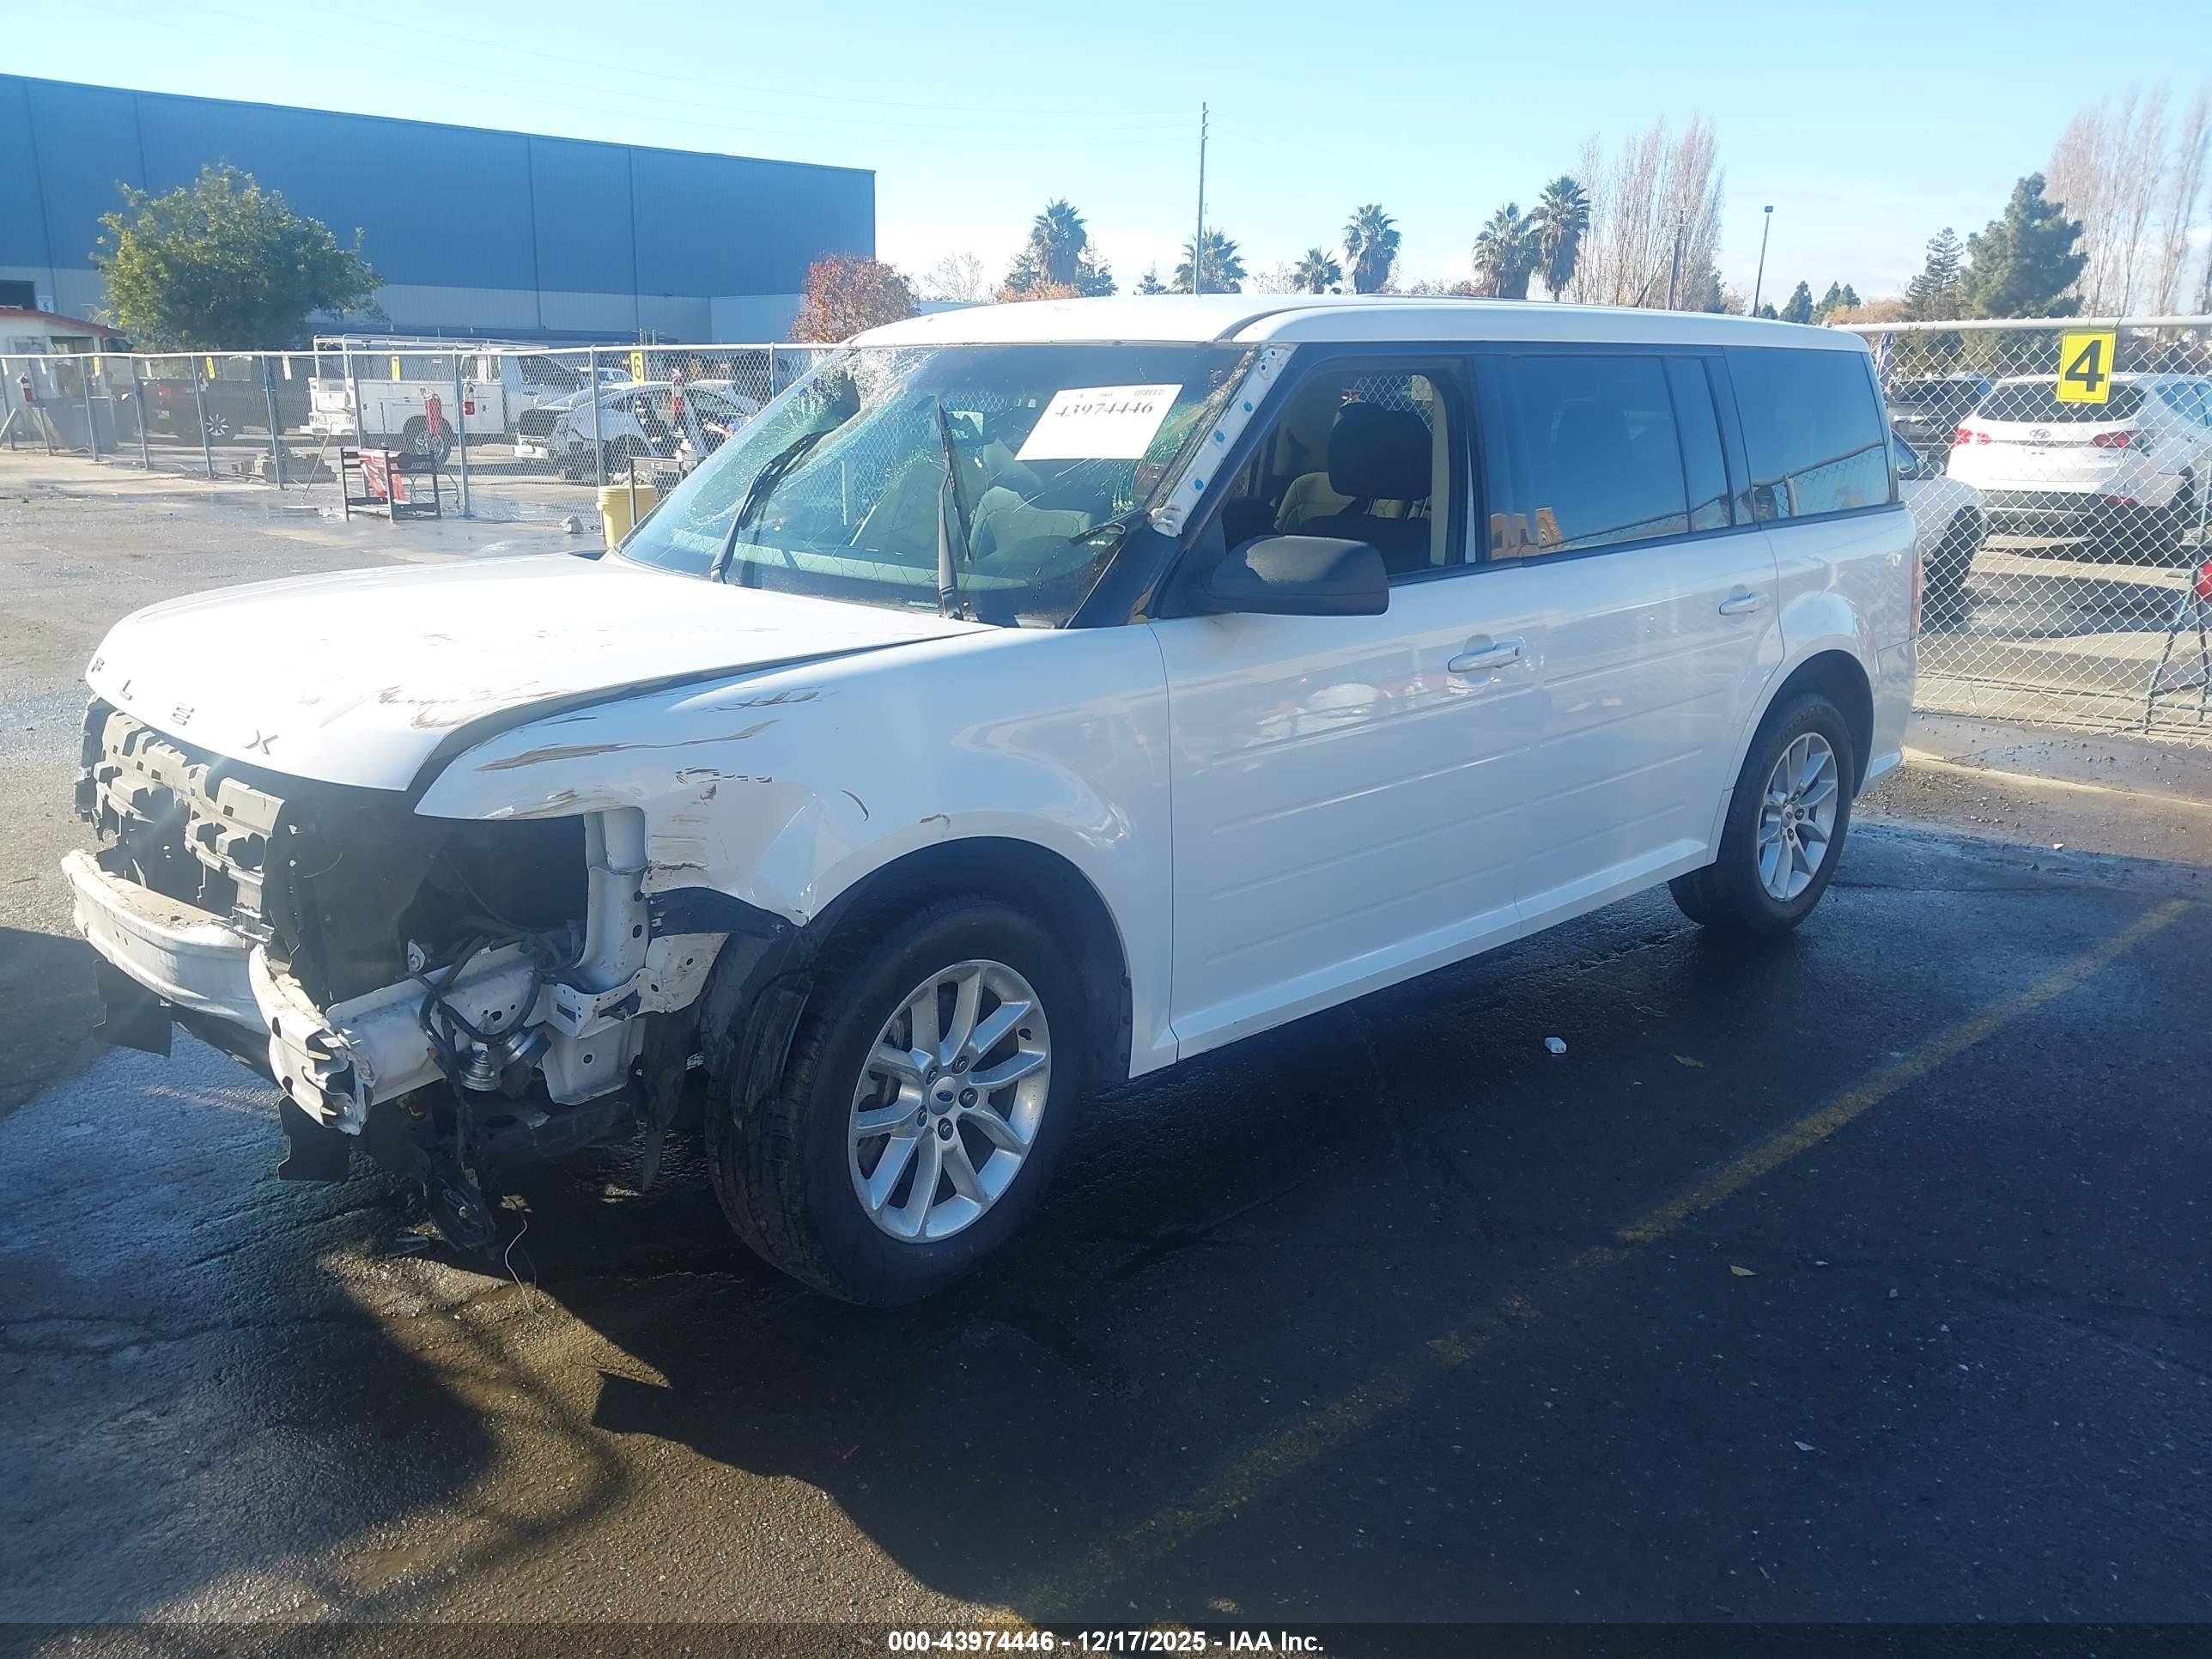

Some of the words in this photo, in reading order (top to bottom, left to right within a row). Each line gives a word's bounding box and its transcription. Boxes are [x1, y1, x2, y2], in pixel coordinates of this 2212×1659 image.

[634, 356, 641, 380] 6
[2065, 340, 2105, 392] 4
[1055, 402, 1153, 416] 43974446
[91, 657, 279, 756] FLEX
